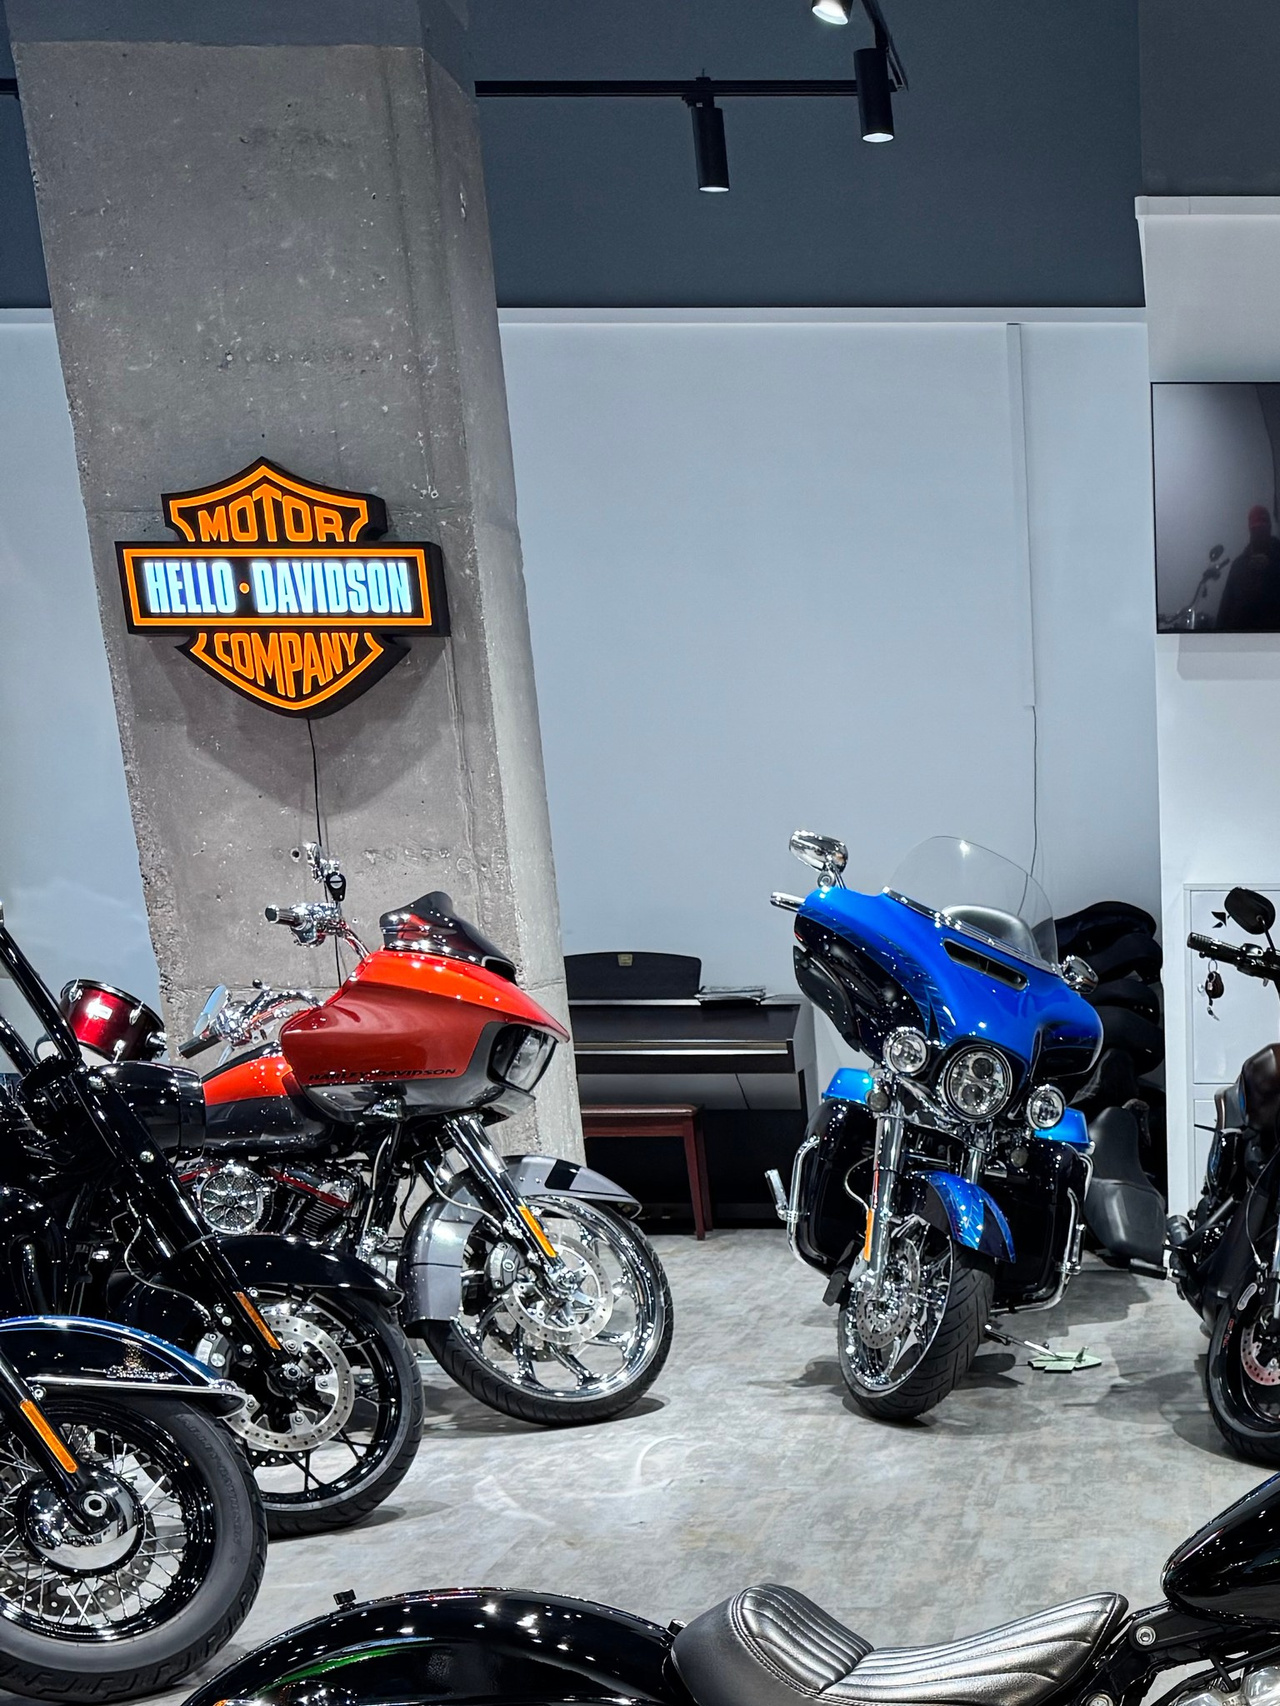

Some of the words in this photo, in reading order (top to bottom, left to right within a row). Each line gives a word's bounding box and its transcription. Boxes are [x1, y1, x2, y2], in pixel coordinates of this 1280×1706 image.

[198, 483, 344, 542] MOTOR
[143, 561, 237, 613] HELLO
[251, 561, 412, 613] DAVIDSON
[213, 633, 358, 697] COMPANY
